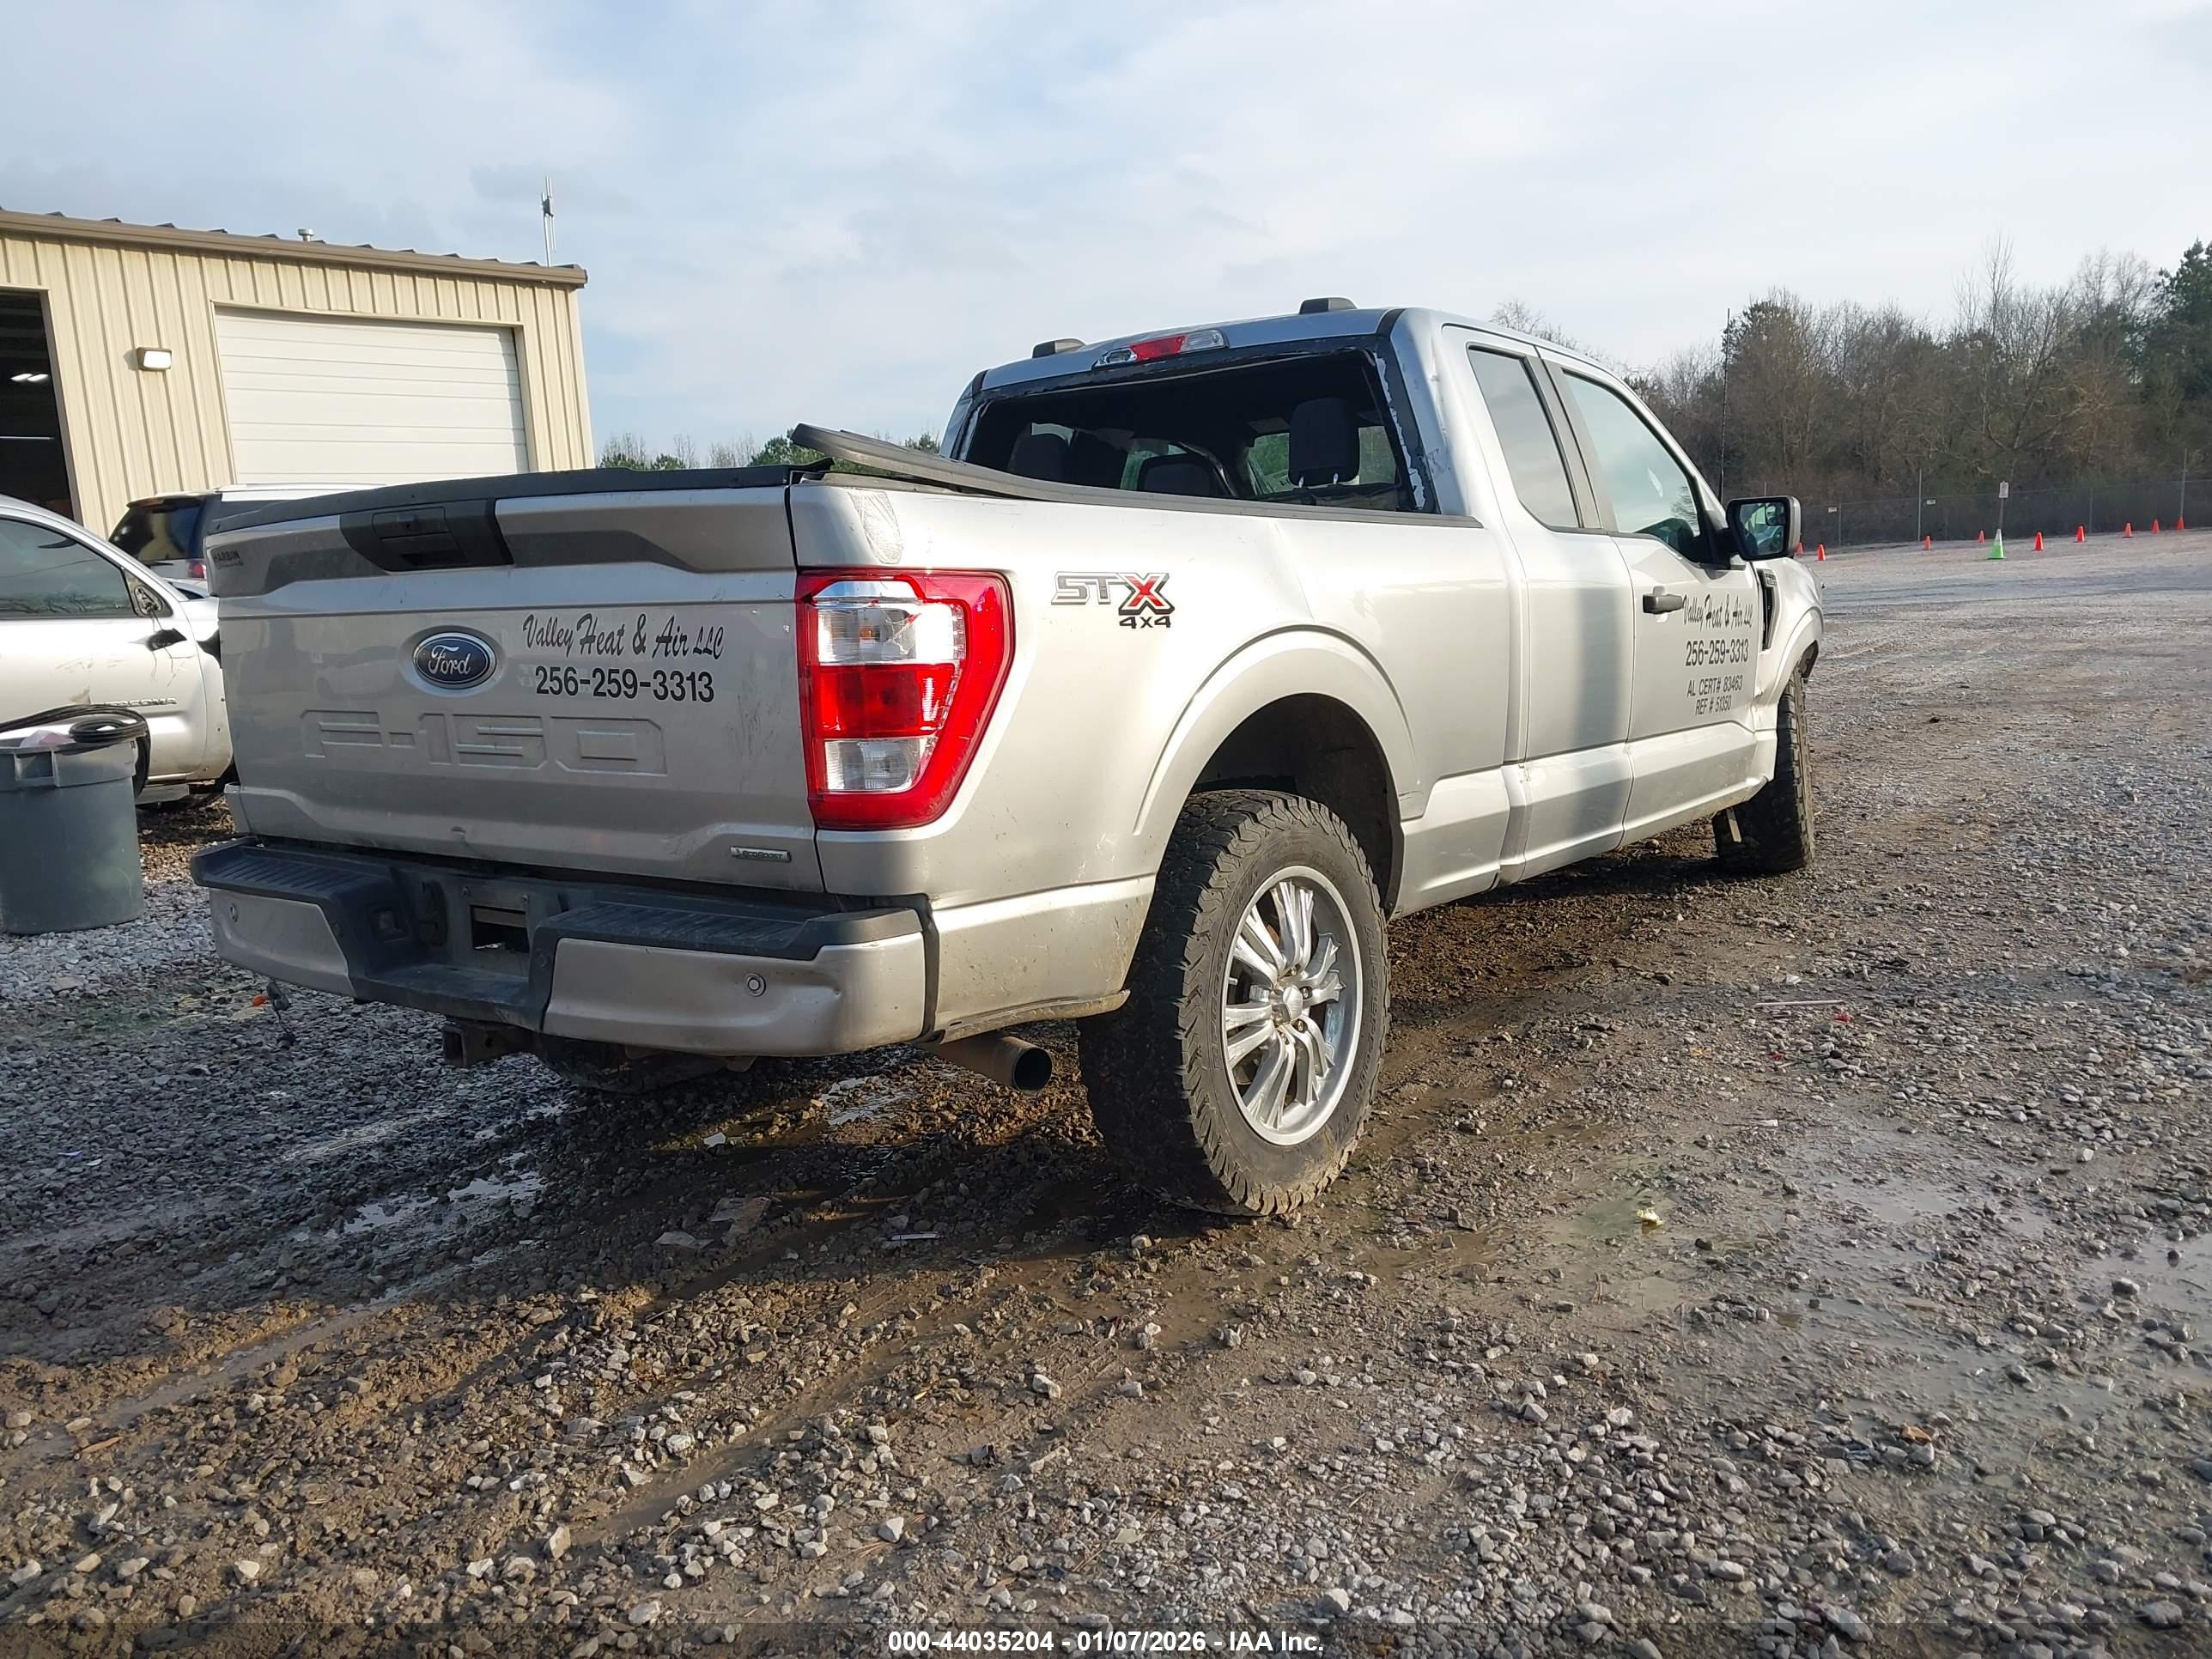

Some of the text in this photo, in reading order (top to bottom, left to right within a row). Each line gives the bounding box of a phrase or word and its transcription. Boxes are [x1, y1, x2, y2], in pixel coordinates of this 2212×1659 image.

[1051, 571, 1176, 616] STX
[1682, 593, 1704, 632] Valley
[1704, 593, 1723, 629] Heat
[1724, 593, 1730, 628] &
[522, 613, 725, 659] Valley Heat & Air LLC
[1686, 638, 1749, 666] 256-259-3313
[428, 644, 471, 676] Ford
[535, 665, 715, 703] 256-259-3313
[1686, 675, 1743, 697] AL CERT# 83463
[1695, 698, 1708, 715] REF
[1709, 696, 1714, 714] #
[301, 709, 668, 776] F-150
